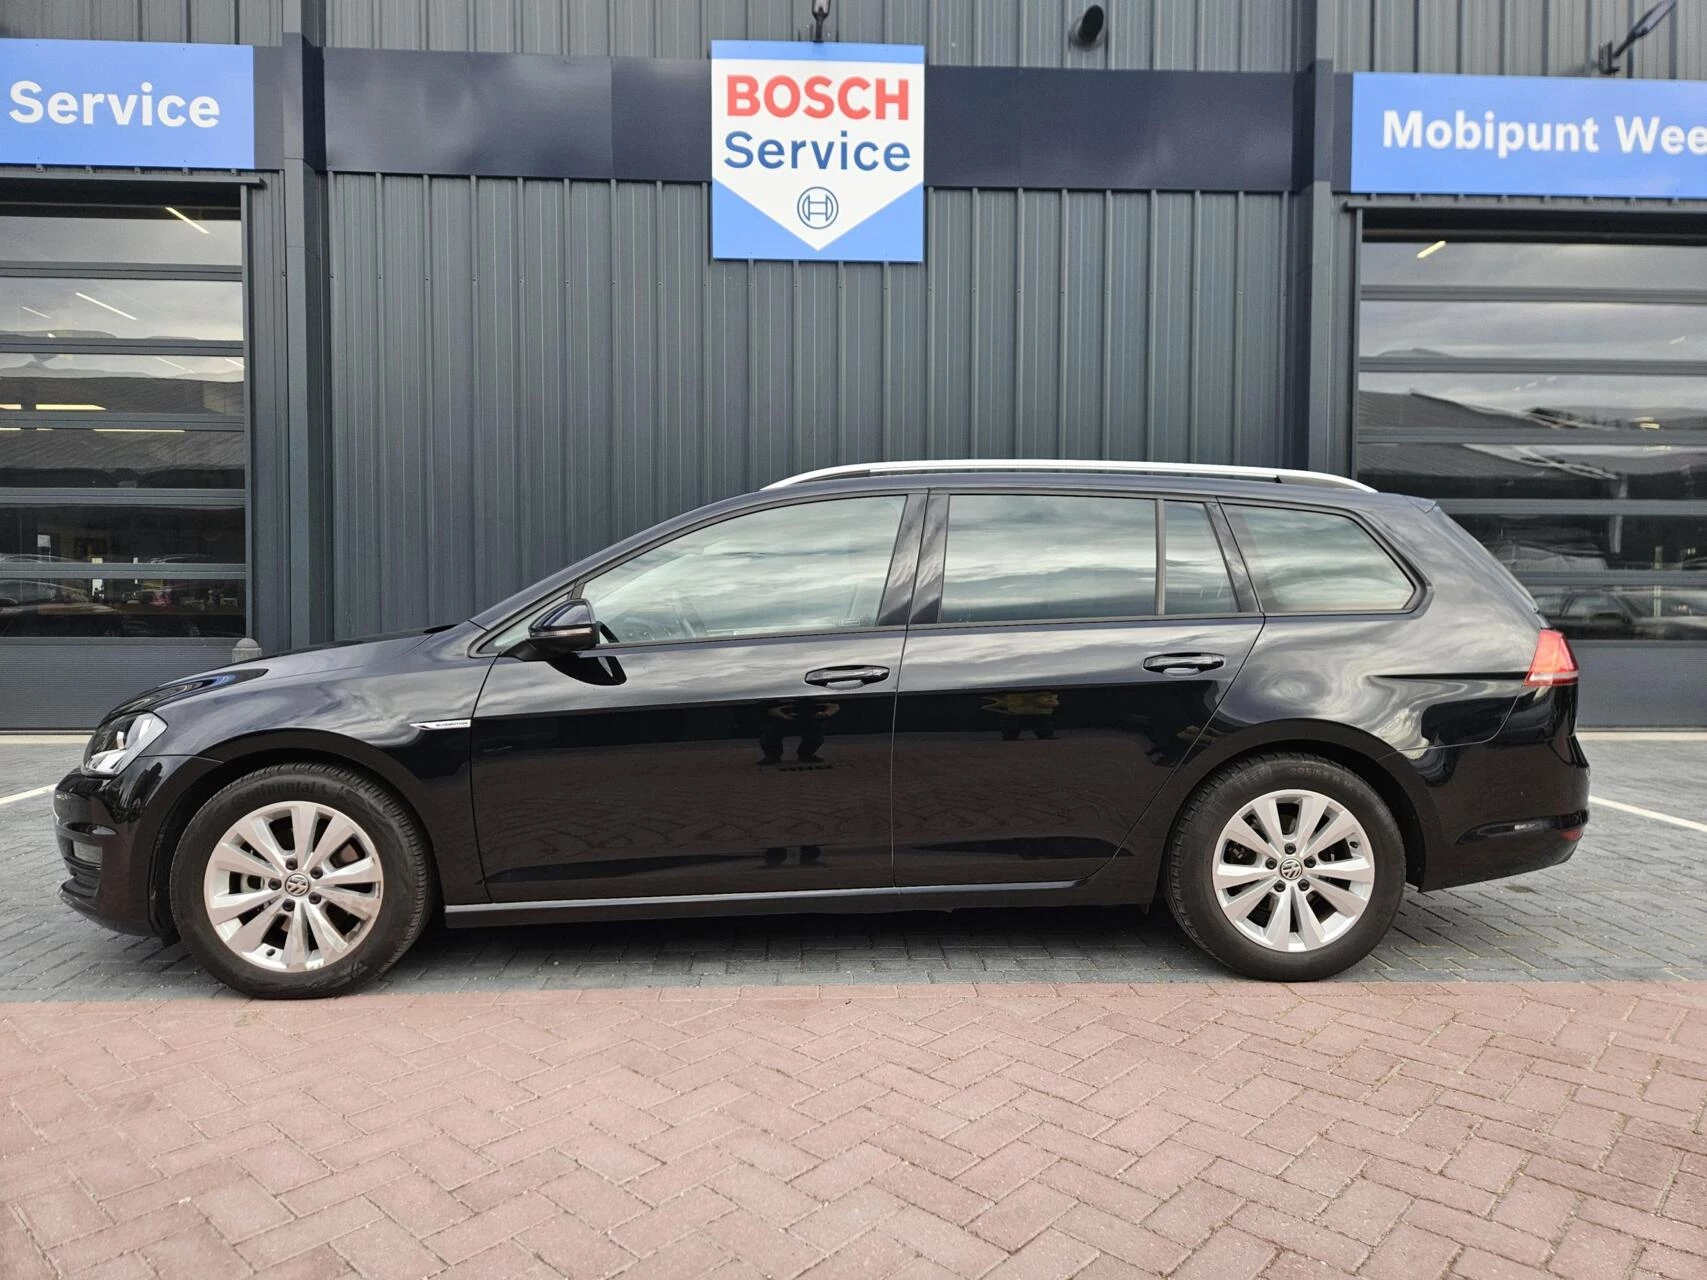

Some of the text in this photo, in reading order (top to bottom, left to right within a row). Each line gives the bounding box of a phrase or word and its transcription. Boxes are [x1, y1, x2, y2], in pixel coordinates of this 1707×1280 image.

[9, 80, 220, 128] Service
[726, 74, 909, 120] BOSCH
[723, 130, 911, 172] Service
[1382, 110, 1707, 159] Mobipunt Wee
